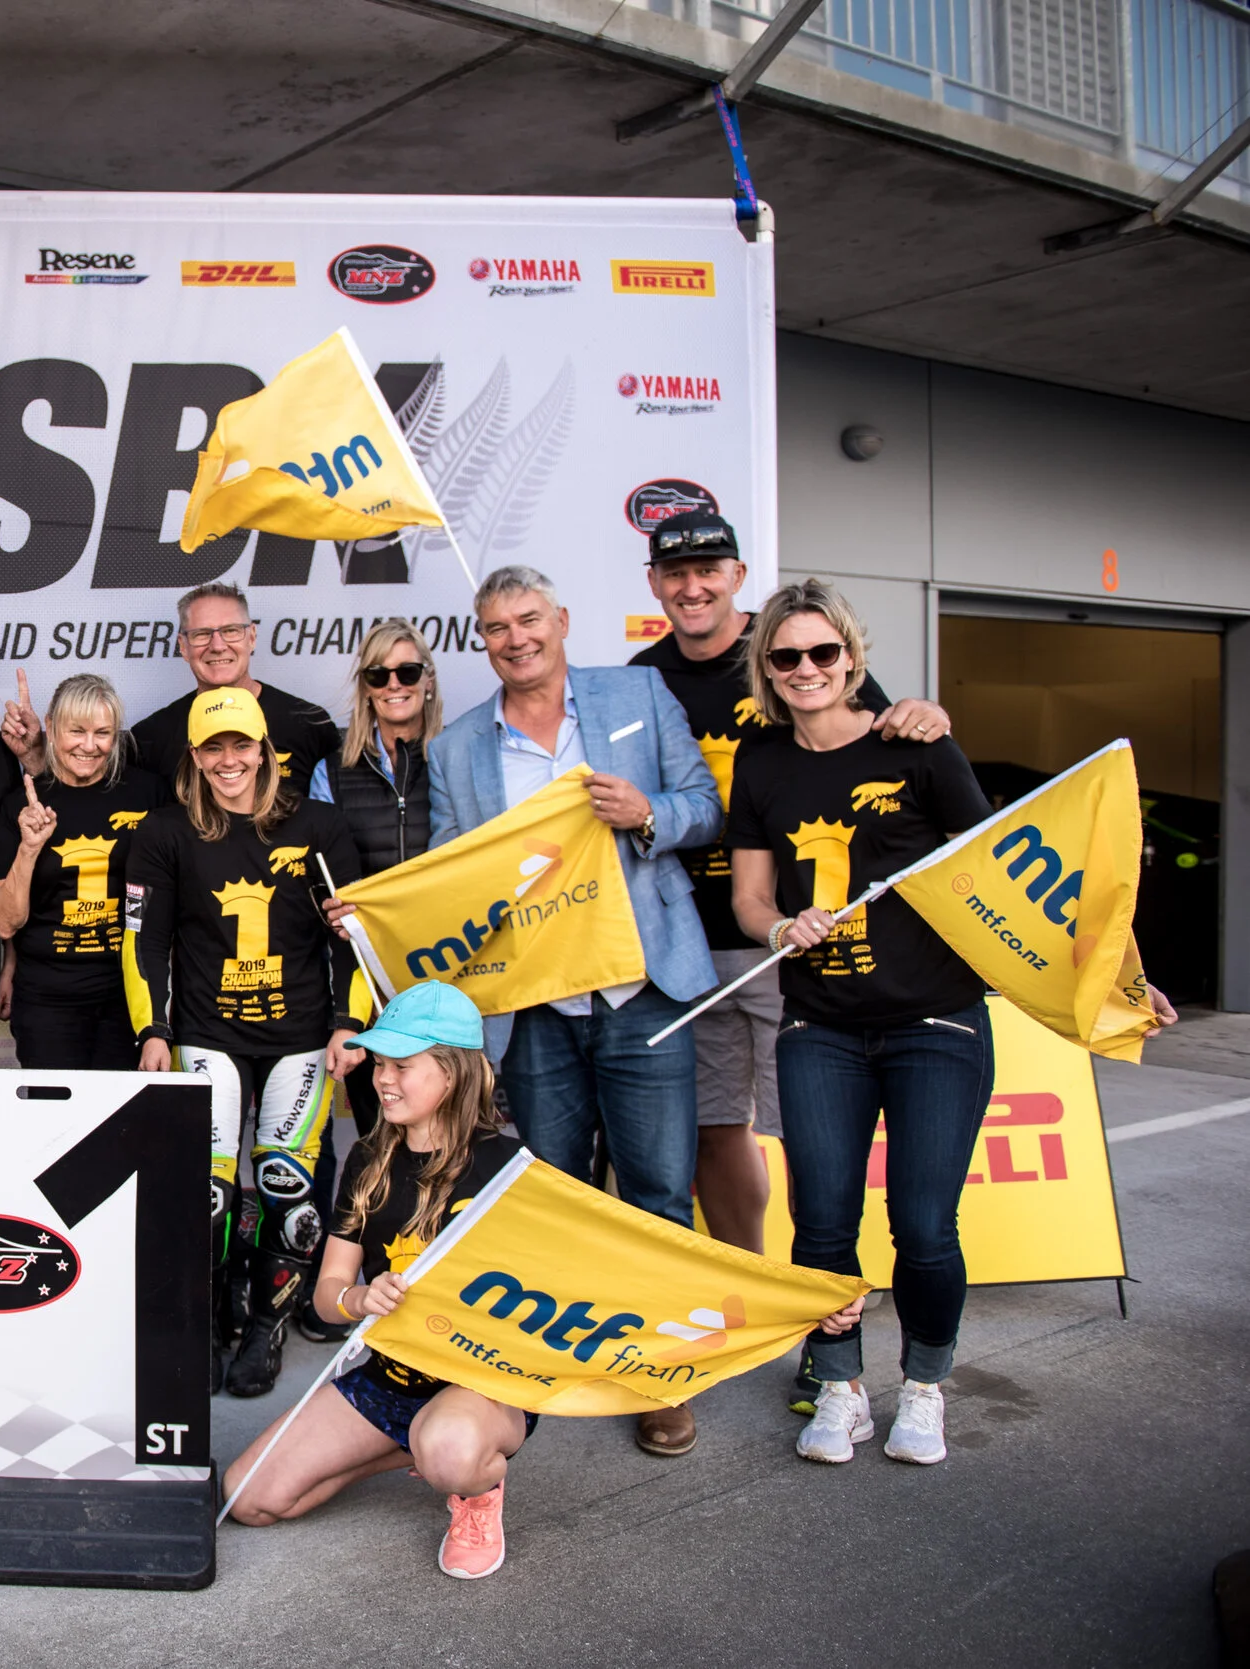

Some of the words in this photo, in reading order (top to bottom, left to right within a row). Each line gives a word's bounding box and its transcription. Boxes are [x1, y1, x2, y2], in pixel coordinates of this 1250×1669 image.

[38, 248, 136, 271] Resene
[493, 258, 581, 282] YAMAHA
[197, 264, 279, 282] DHL
[346, 269, 403, 284] MNZ
[619, 265, 706, 290] PIRELLI
[641, 375, 722, 401] YAMAHA
[1101, 548, 1119, 592] 8
[205, 701, 224, 715] mtf
[991, 824, 1085, 940] mt
[77, 901, 105, 912] 2019
[504, 879, 600, 931] finance
[965, 894, 1049, 972] mtf.co.nz
[221, 970, 282, 986] CHAMPION
[238, 959, 266, 972] 2019
[273, 1062, 318, 1142] Kawasaki
[261, 1173, 301, 1187] RST
[33, 1083, 213, 1467] 1
[459, 1270, 645, 1363] mtf
[449, 1331, 558, 1387] mtf.co.nz
[145, 1422, 189, 1456] ST
